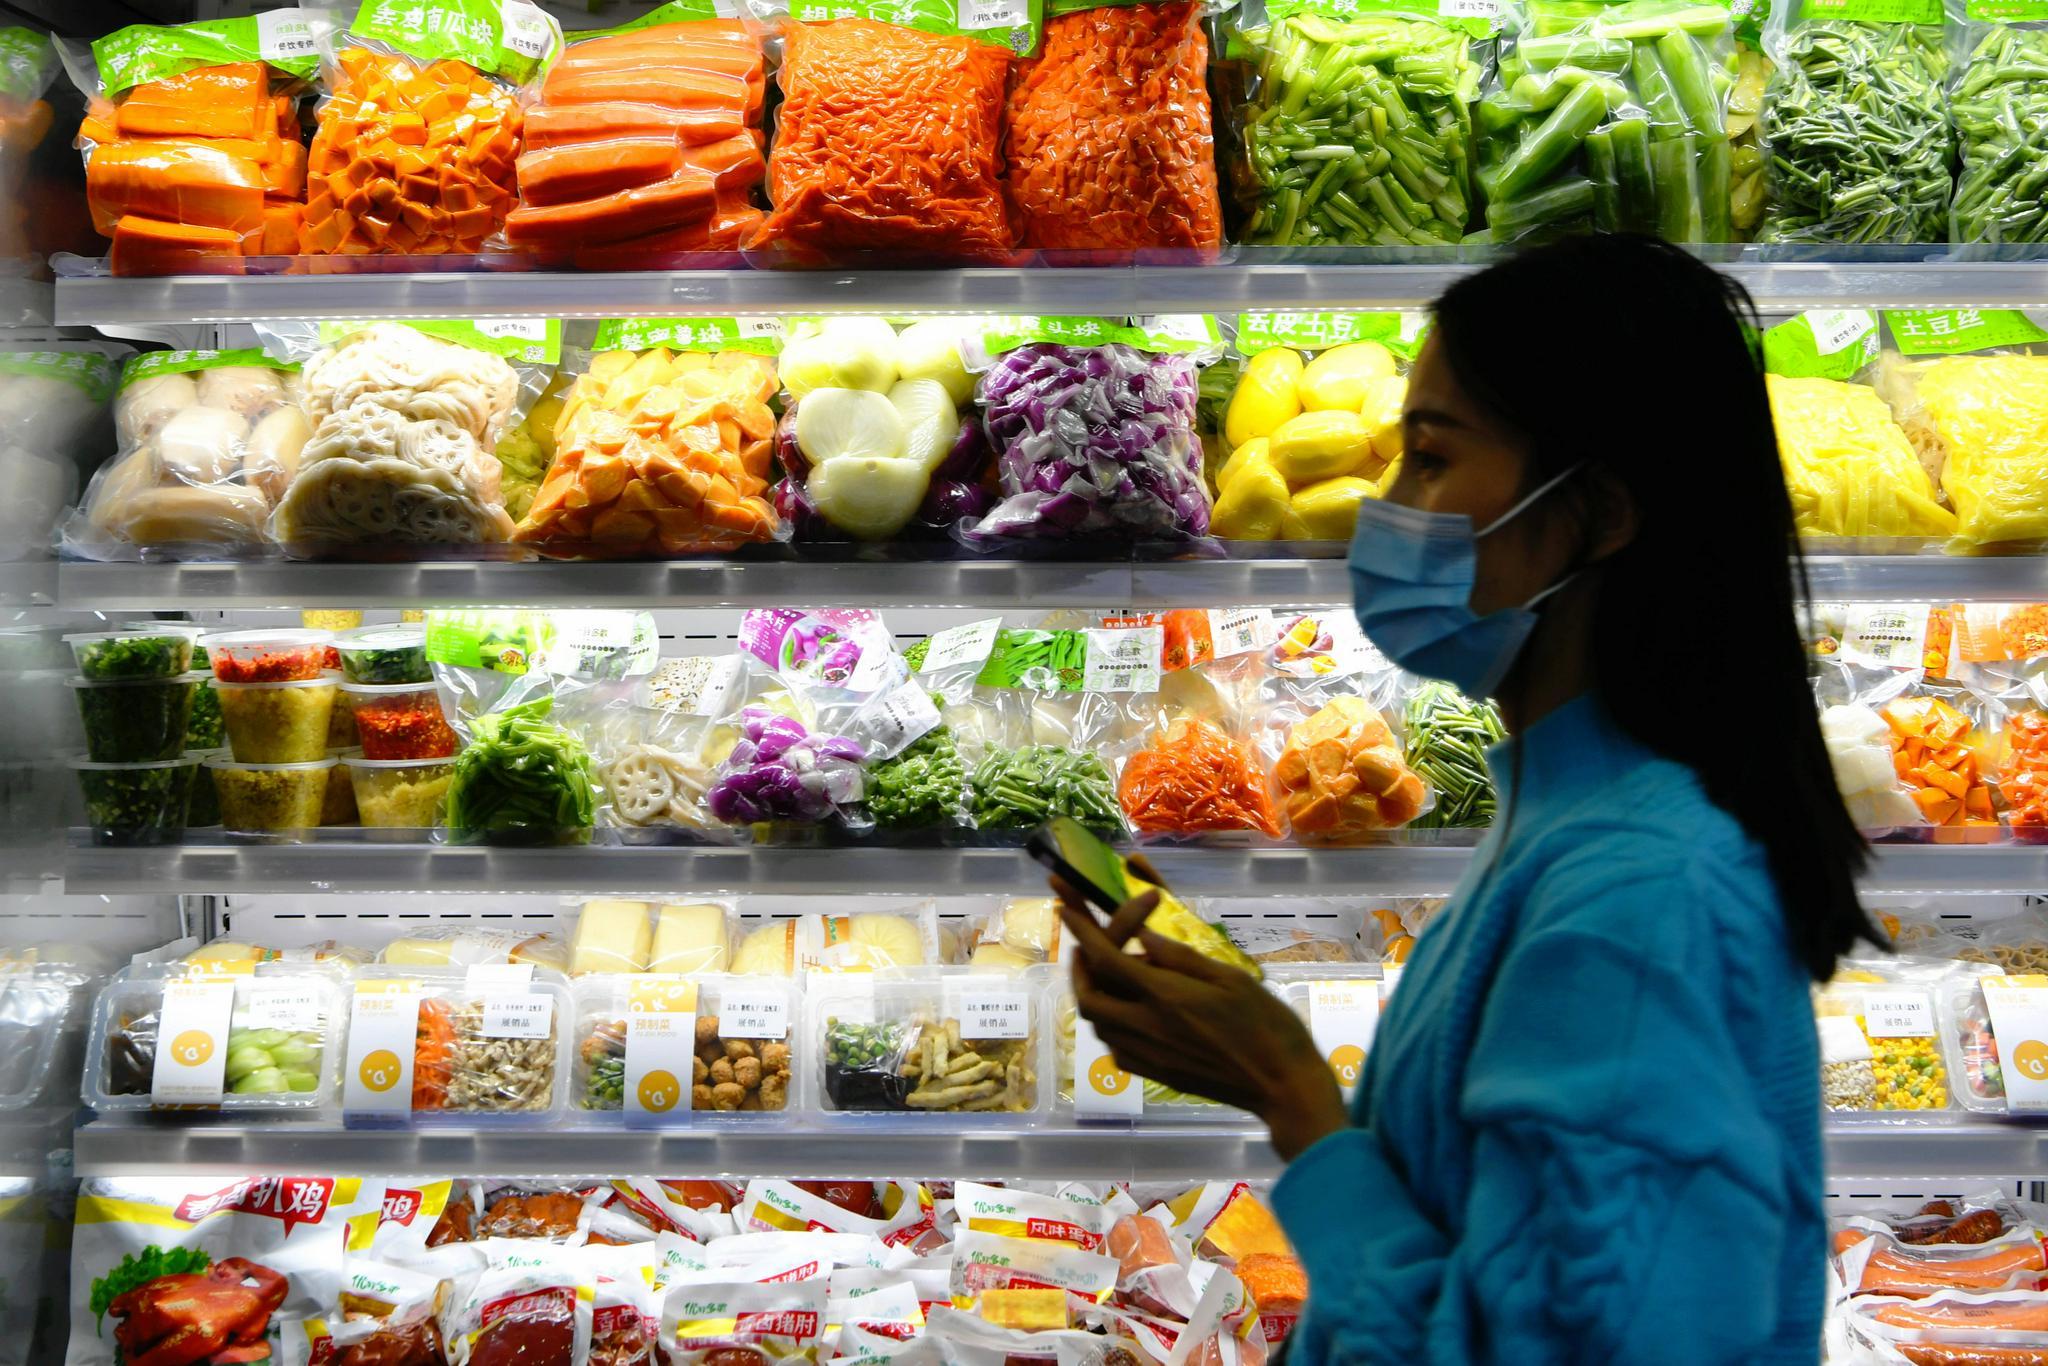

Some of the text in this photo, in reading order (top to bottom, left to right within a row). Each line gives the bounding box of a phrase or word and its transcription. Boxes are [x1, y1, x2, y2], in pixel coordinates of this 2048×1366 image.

[371, 6, 494, 46] 去皮南瓜块
[1247, 313, 1359, 341] 去皮土豆
[1902, 310, 1985, 337] 土豆丝
